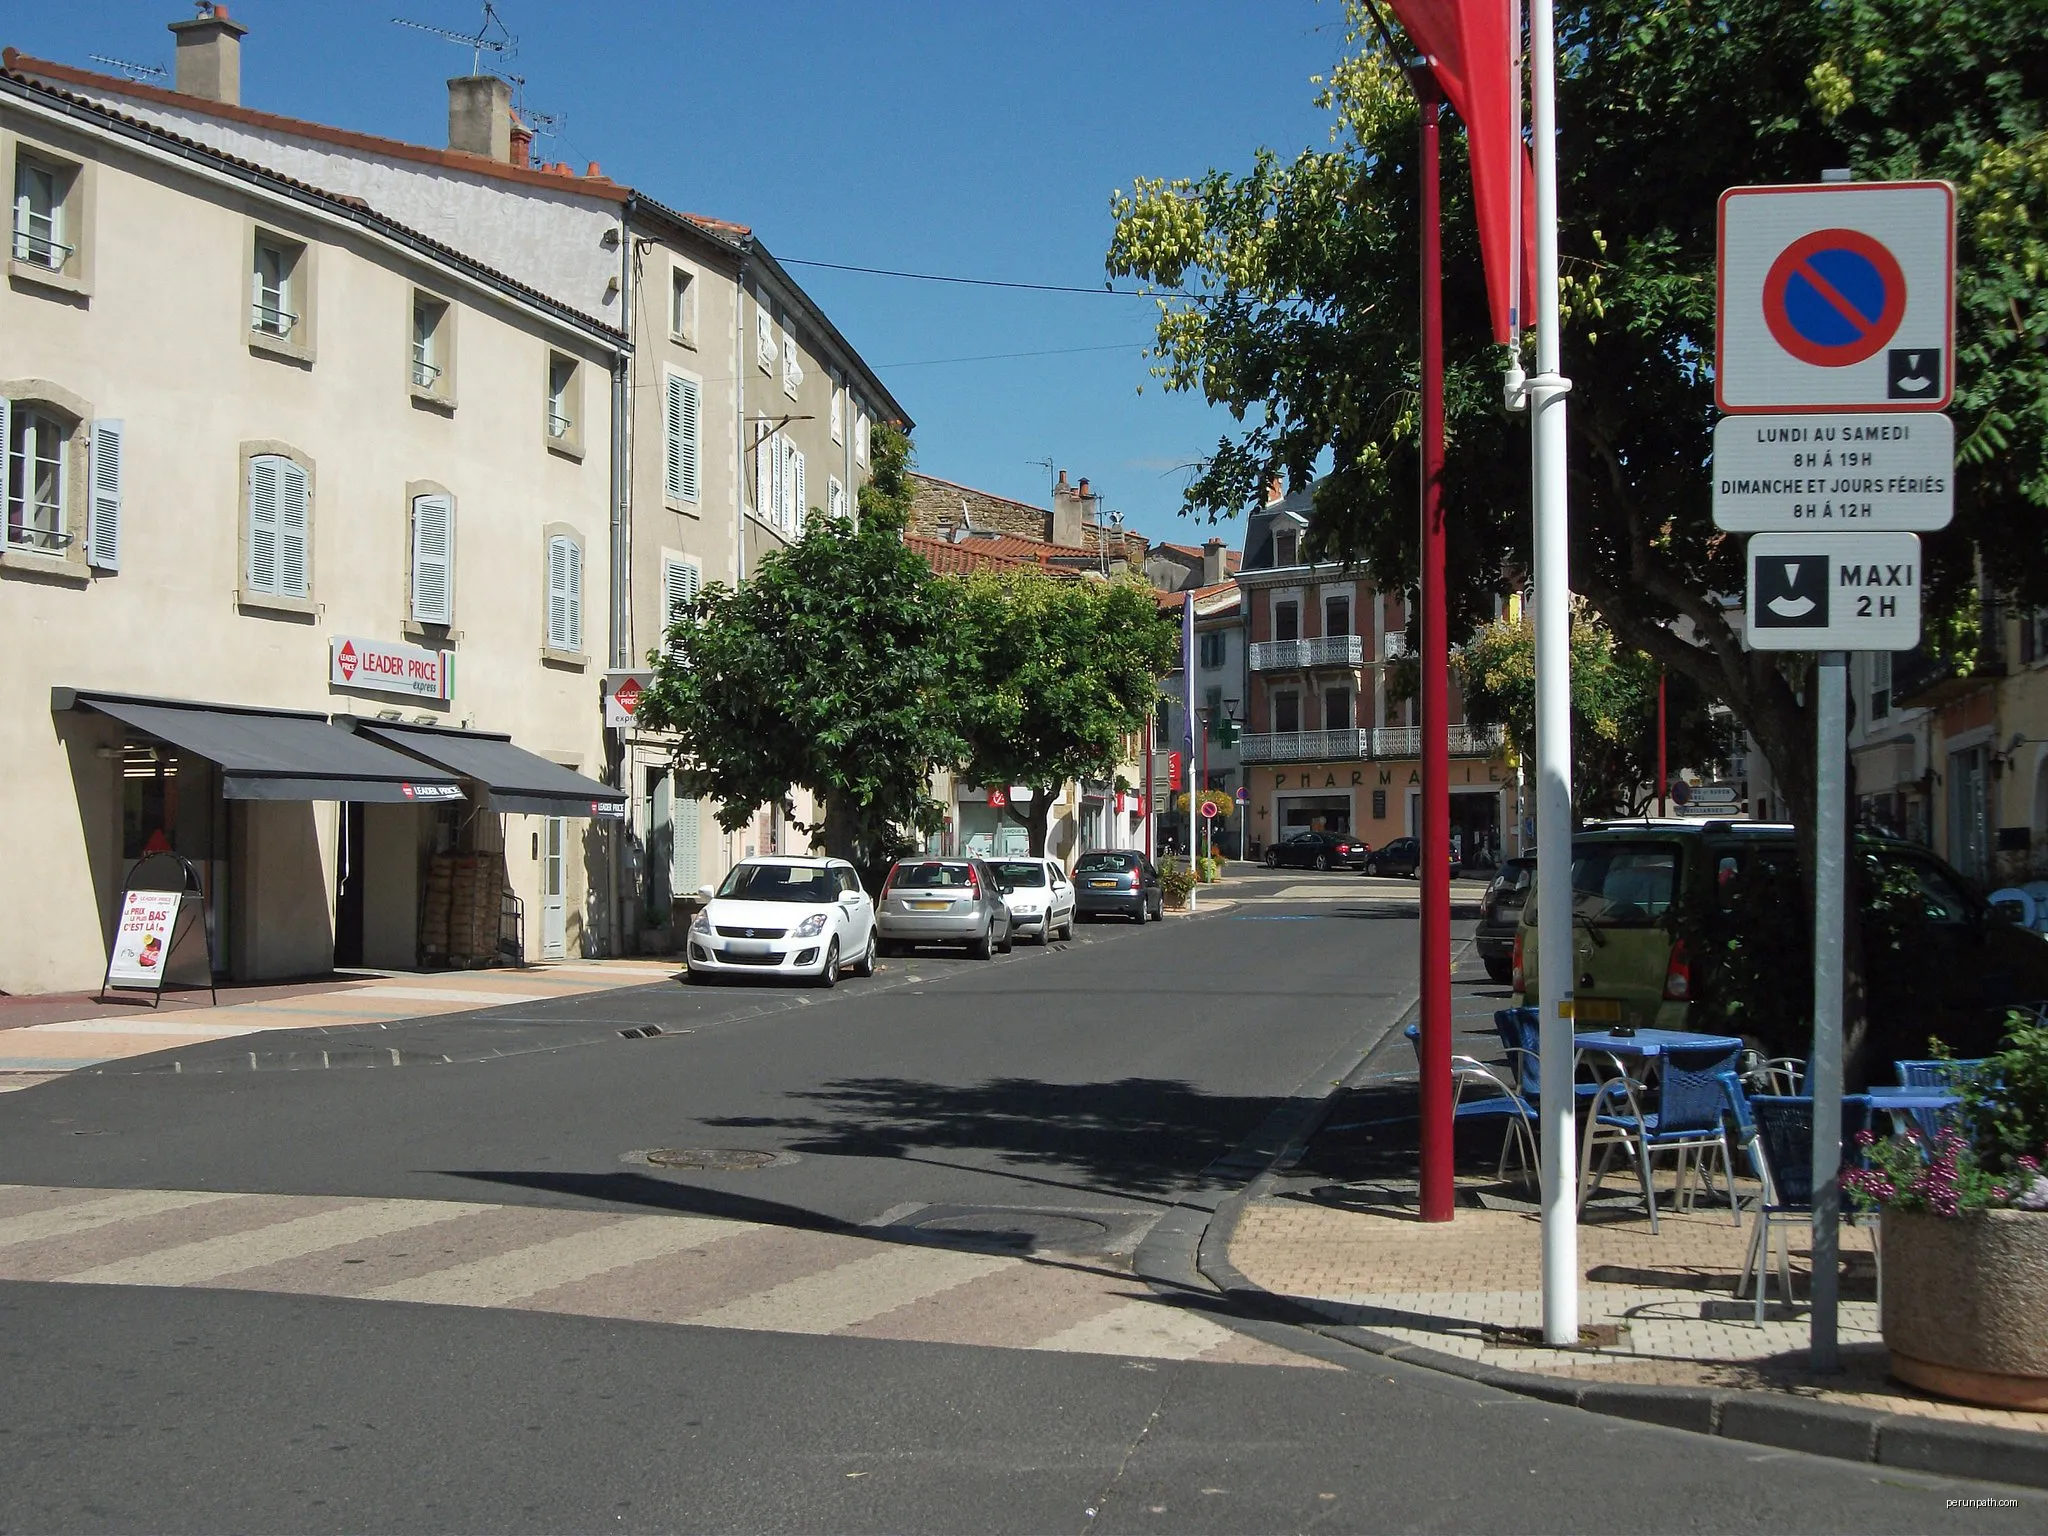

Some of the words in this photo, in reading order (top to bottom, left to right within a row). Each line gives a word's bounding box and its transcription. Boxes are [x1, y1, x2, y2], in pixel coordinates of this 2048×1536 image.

[1757, 427, 1808, 443] LUNDI
[1813, 426, 1836, 442] AU
[1842, 425, 1910, 441] SAMEDI
[1793, 453, 1817, 467] 8H
[1840, 452, 1873, 467] 19H
[1721, 479, 1803, 495] DIMANCHE
[1807, 479, 1826, 494] ET
[1830, 478, 1884, 494] JOURS
[1888, 475, 1945, 494] FÉRIÉS
[1793, 503, 1817, 519] 8H
[1839, 503, 1872, 518] 12H
[1840, 564, 1913, 587] MAXI
[1856, 595, 1896, 618] 2H
[362, 651, 404, 676] LEADER
[408, 659, 437, 681] PRICE
[412, 681, 437, 694] express
[1275, 766, 1500, 789] PHARMAIE
[413, 786, 439, 796] LEADER
[123, 923, 144, 932] C'EST
